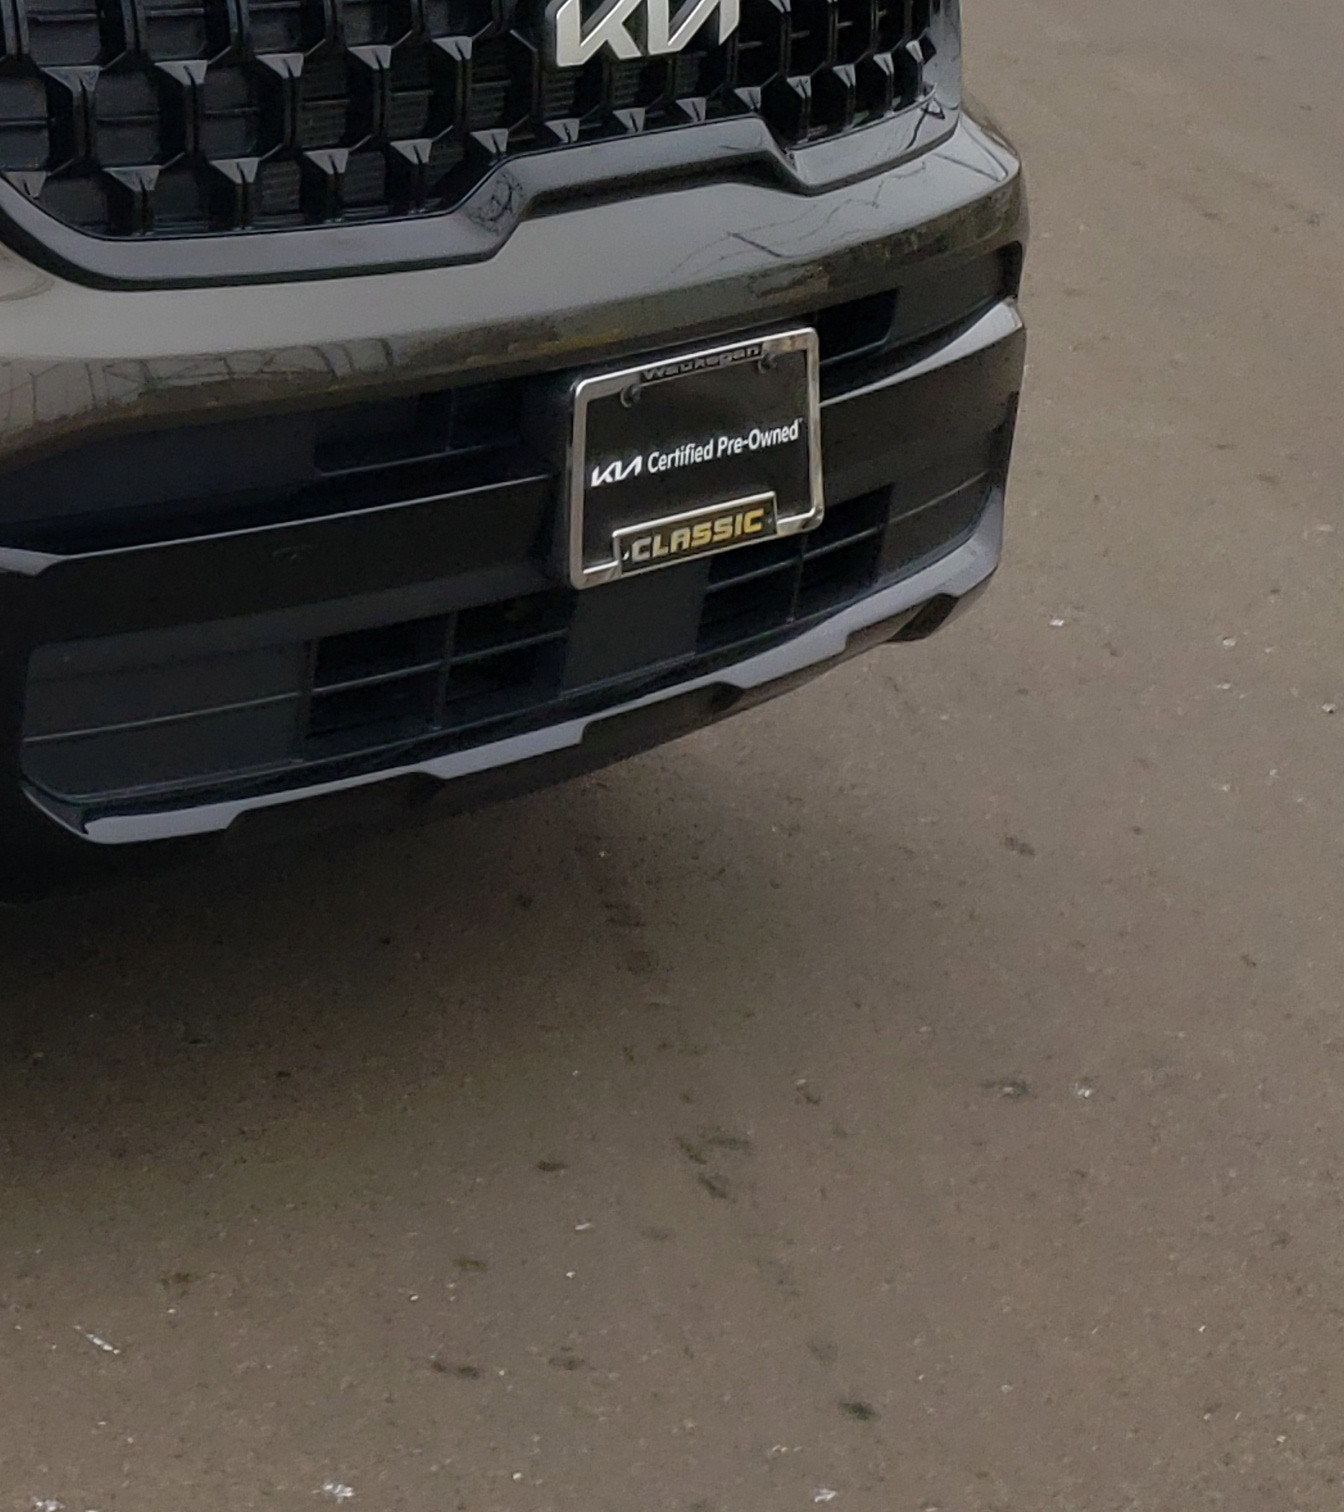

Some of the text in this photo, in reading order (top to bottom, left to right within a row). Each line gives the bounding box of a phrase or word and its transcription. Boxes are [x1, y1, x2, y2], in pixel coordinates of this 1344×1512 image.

[590, 422, 799, 487] KIA Certified Pre-Owned
[630, 508, 765, 563] CLASSIC
